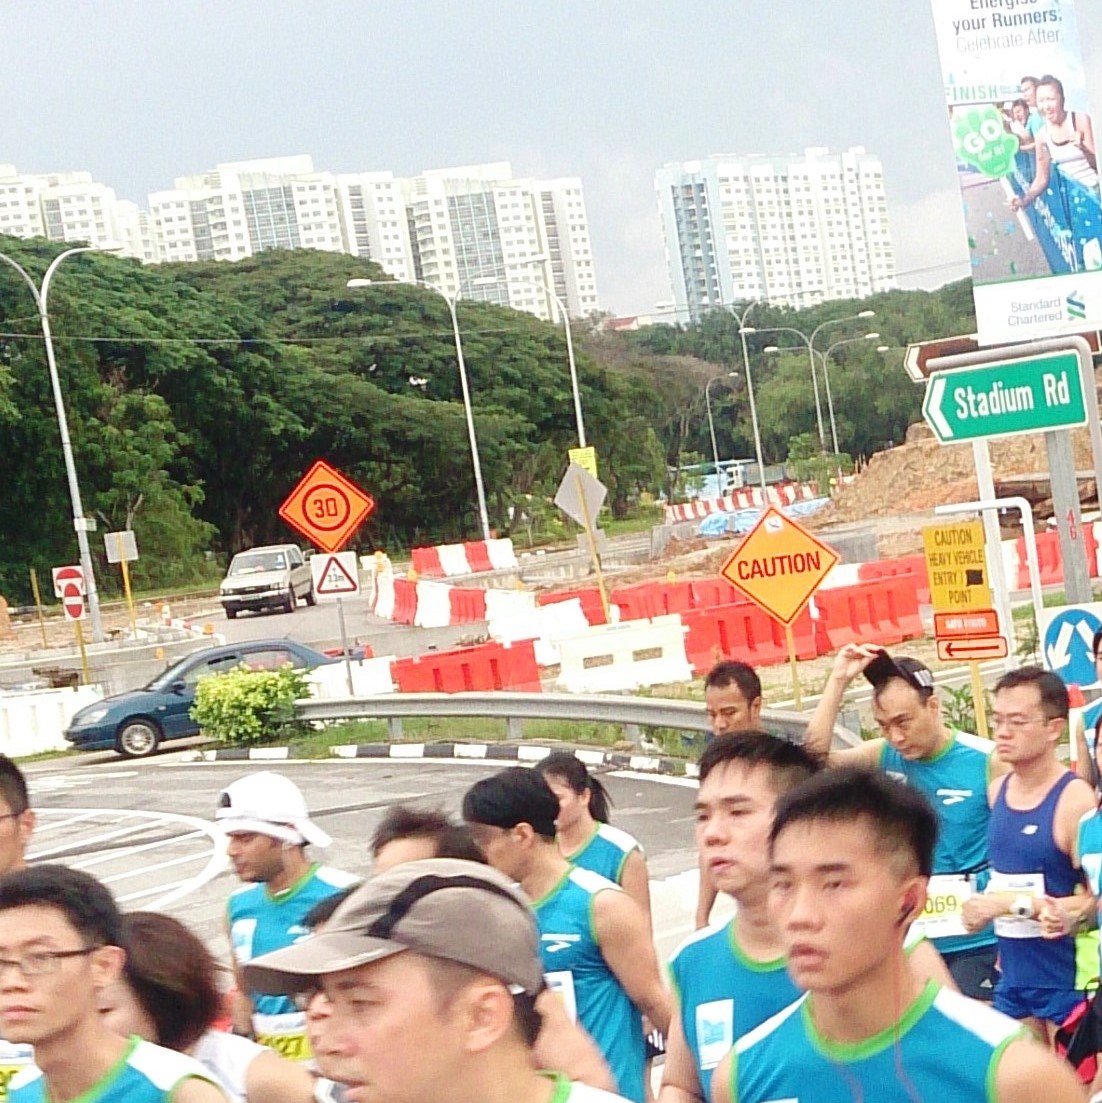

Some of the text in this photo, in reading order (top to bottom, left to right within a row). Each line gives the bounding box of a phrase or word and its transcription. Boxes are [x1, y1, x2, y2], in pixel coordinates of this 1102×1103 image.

[952, 17, 987, 36] your
[963, 118, 1002, 155] GO
[1011, 296, 1061, 313] Standard
[1007, 310, 1063, 327] Chartered
[953, 371, 1071, 420] Stadium Rd
[313, 497, 338, 518] 30
[934, 528, 973, 547] CAUTION
[737, 551, 821, 581] CAUTION
[928, 549, 984, 567] HEAVY VEHICLE
[933, 570, 957, 586] ENTRY
[948, 589, 972, 605] POINT
